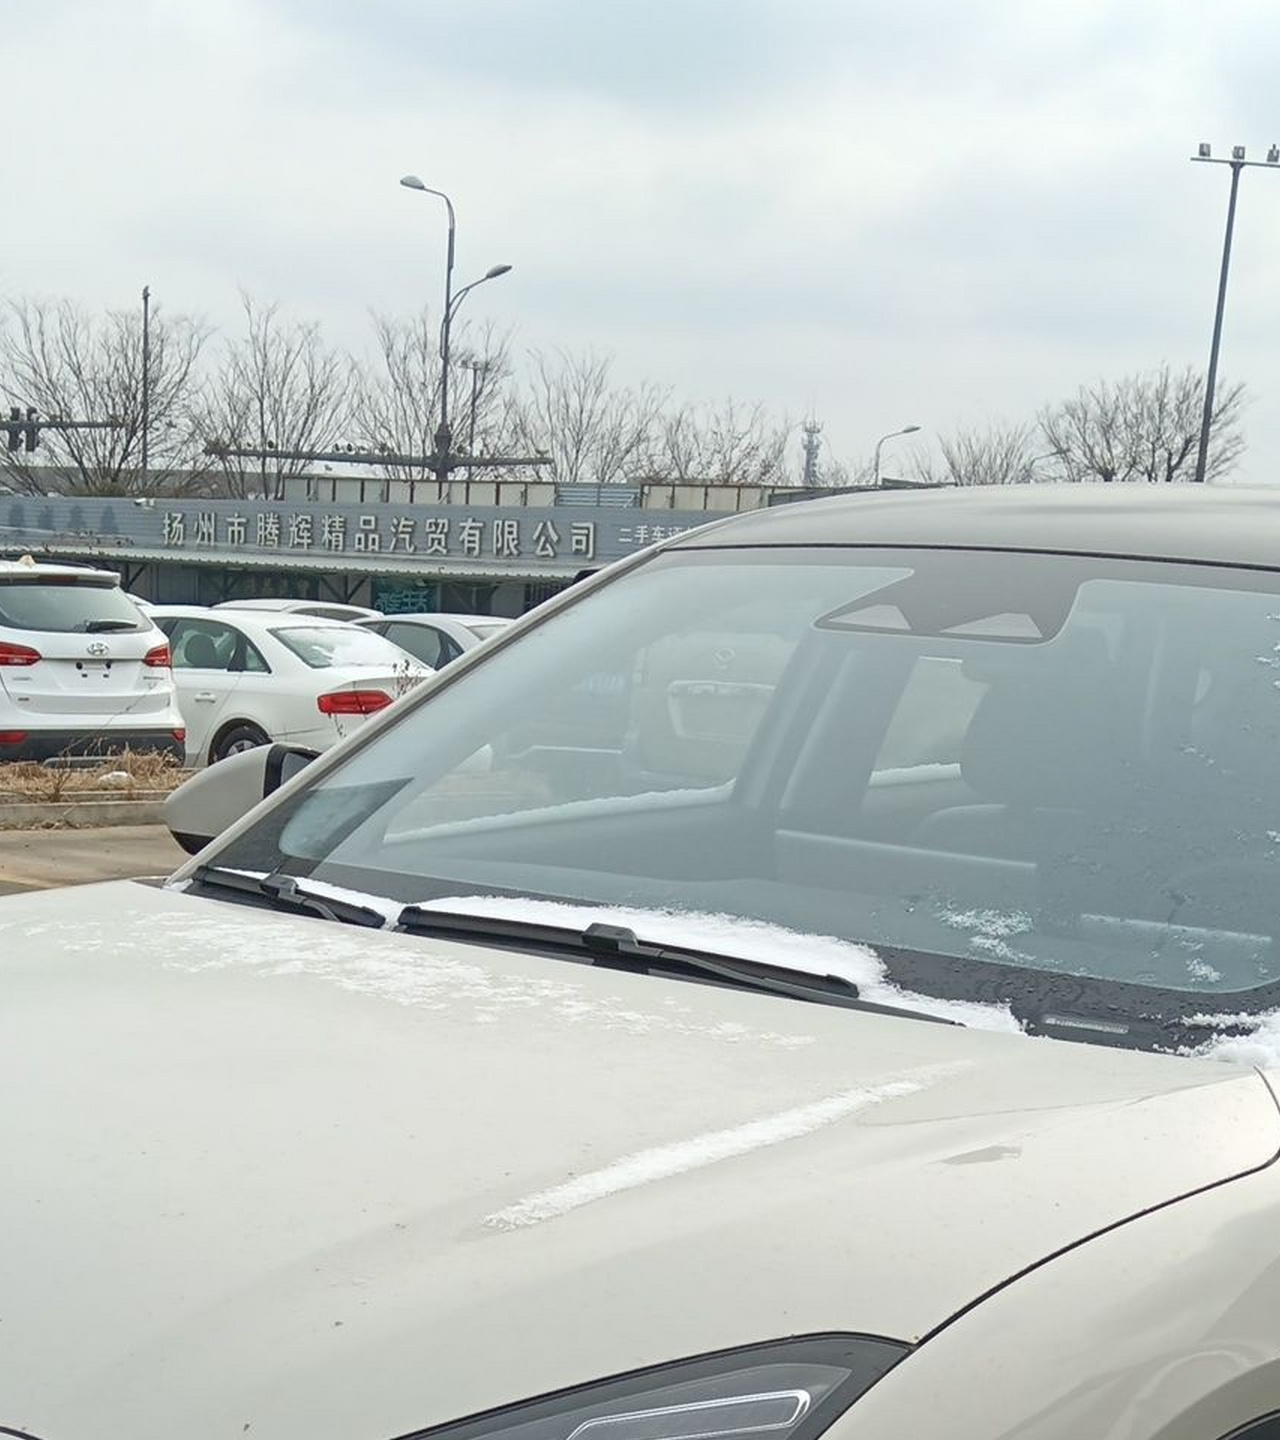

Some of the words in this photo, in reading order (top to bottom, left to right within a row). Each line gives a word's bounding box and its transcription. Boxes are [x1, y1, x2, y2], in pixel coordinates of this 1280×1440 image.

[162, 511, 595, 559] 扬州市腾辉精品汽贸有限公司
[618, 524, 691, 544] 二手车
